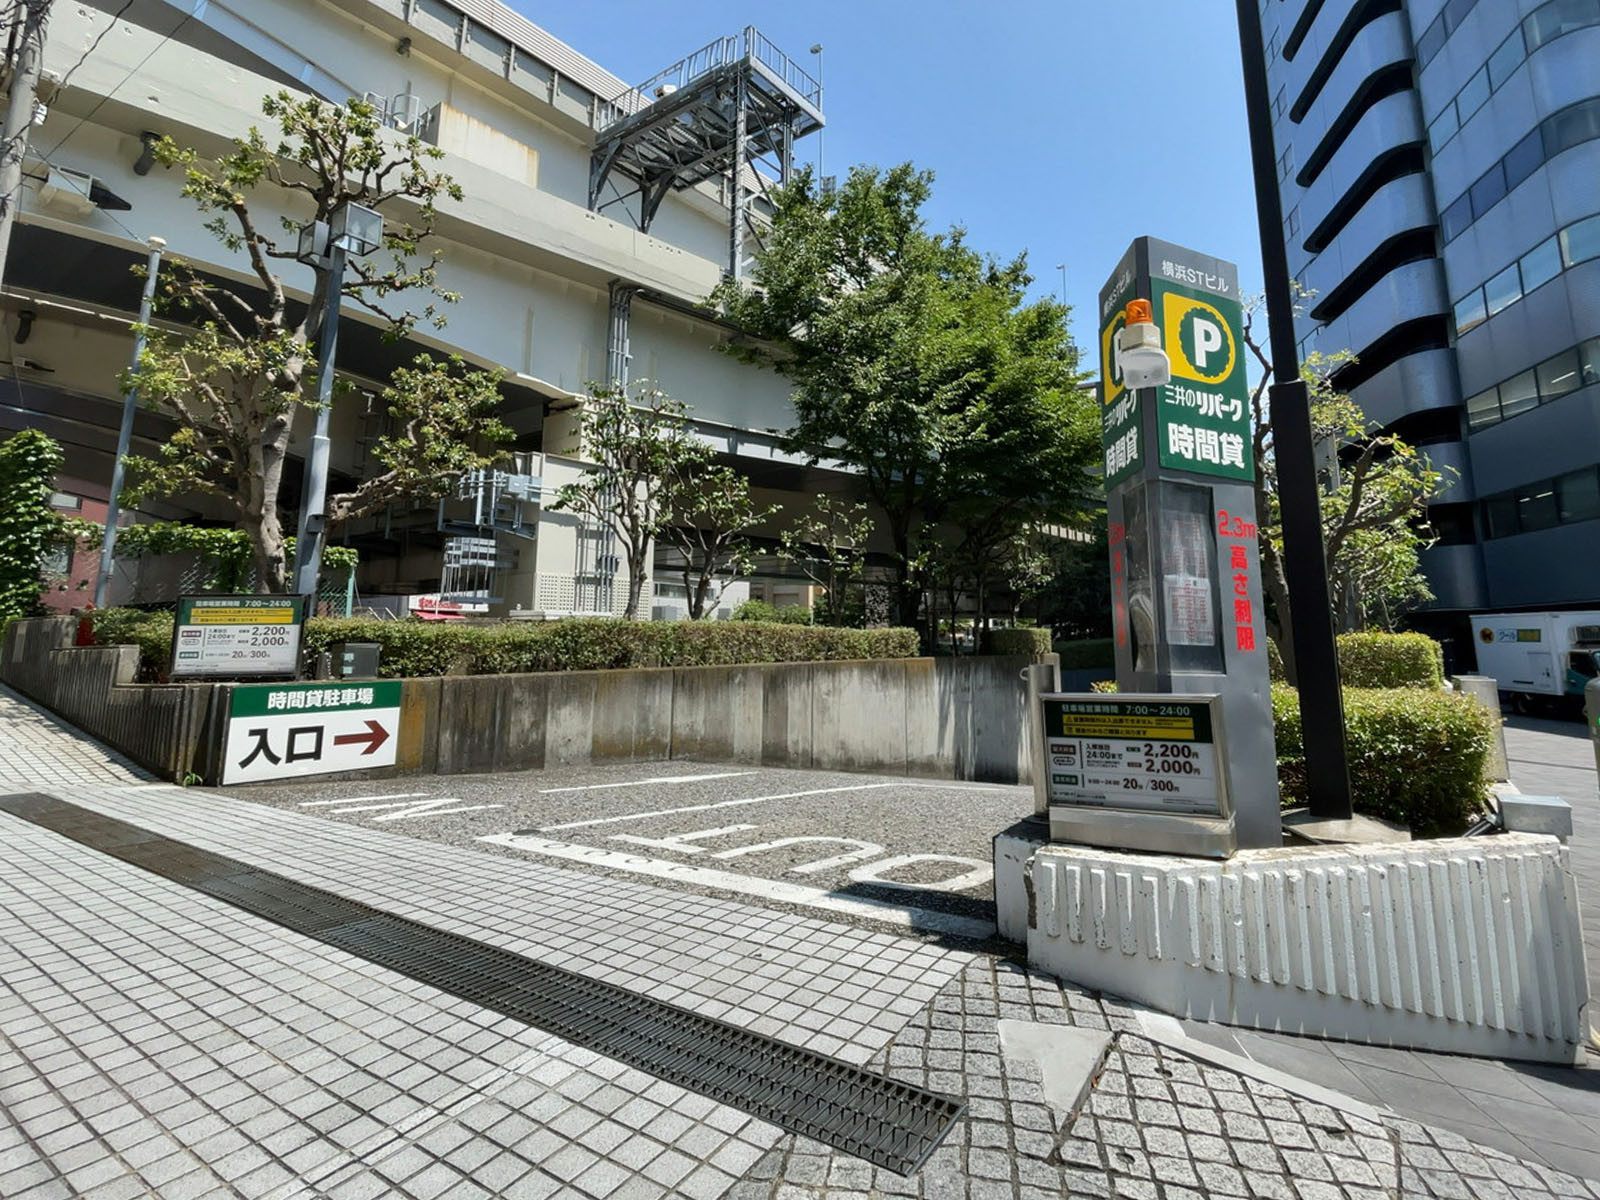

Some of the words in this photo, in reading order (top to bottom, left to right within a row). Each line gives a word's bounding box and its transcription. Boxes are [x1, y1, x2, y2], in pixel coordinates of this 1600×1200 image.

[1161, 259, 1230, 294] 横浜STビル
[1192, 316, 1223, 368] P
[1164, 384, 1243, 422] 三井のリパーク
[1106, 425, 1138, 478] 時間貸
[1168, 423, 1245, 469] 時間貸
[1216, 509, 1257, 539] 2.3m
[1230, 545, 1255, 651] 高さ制限
[267, 687, 374, 710] 時間貸駐車場
[237, 725, 325, 770] 入口
[606, 823, 994, 891] OUT
